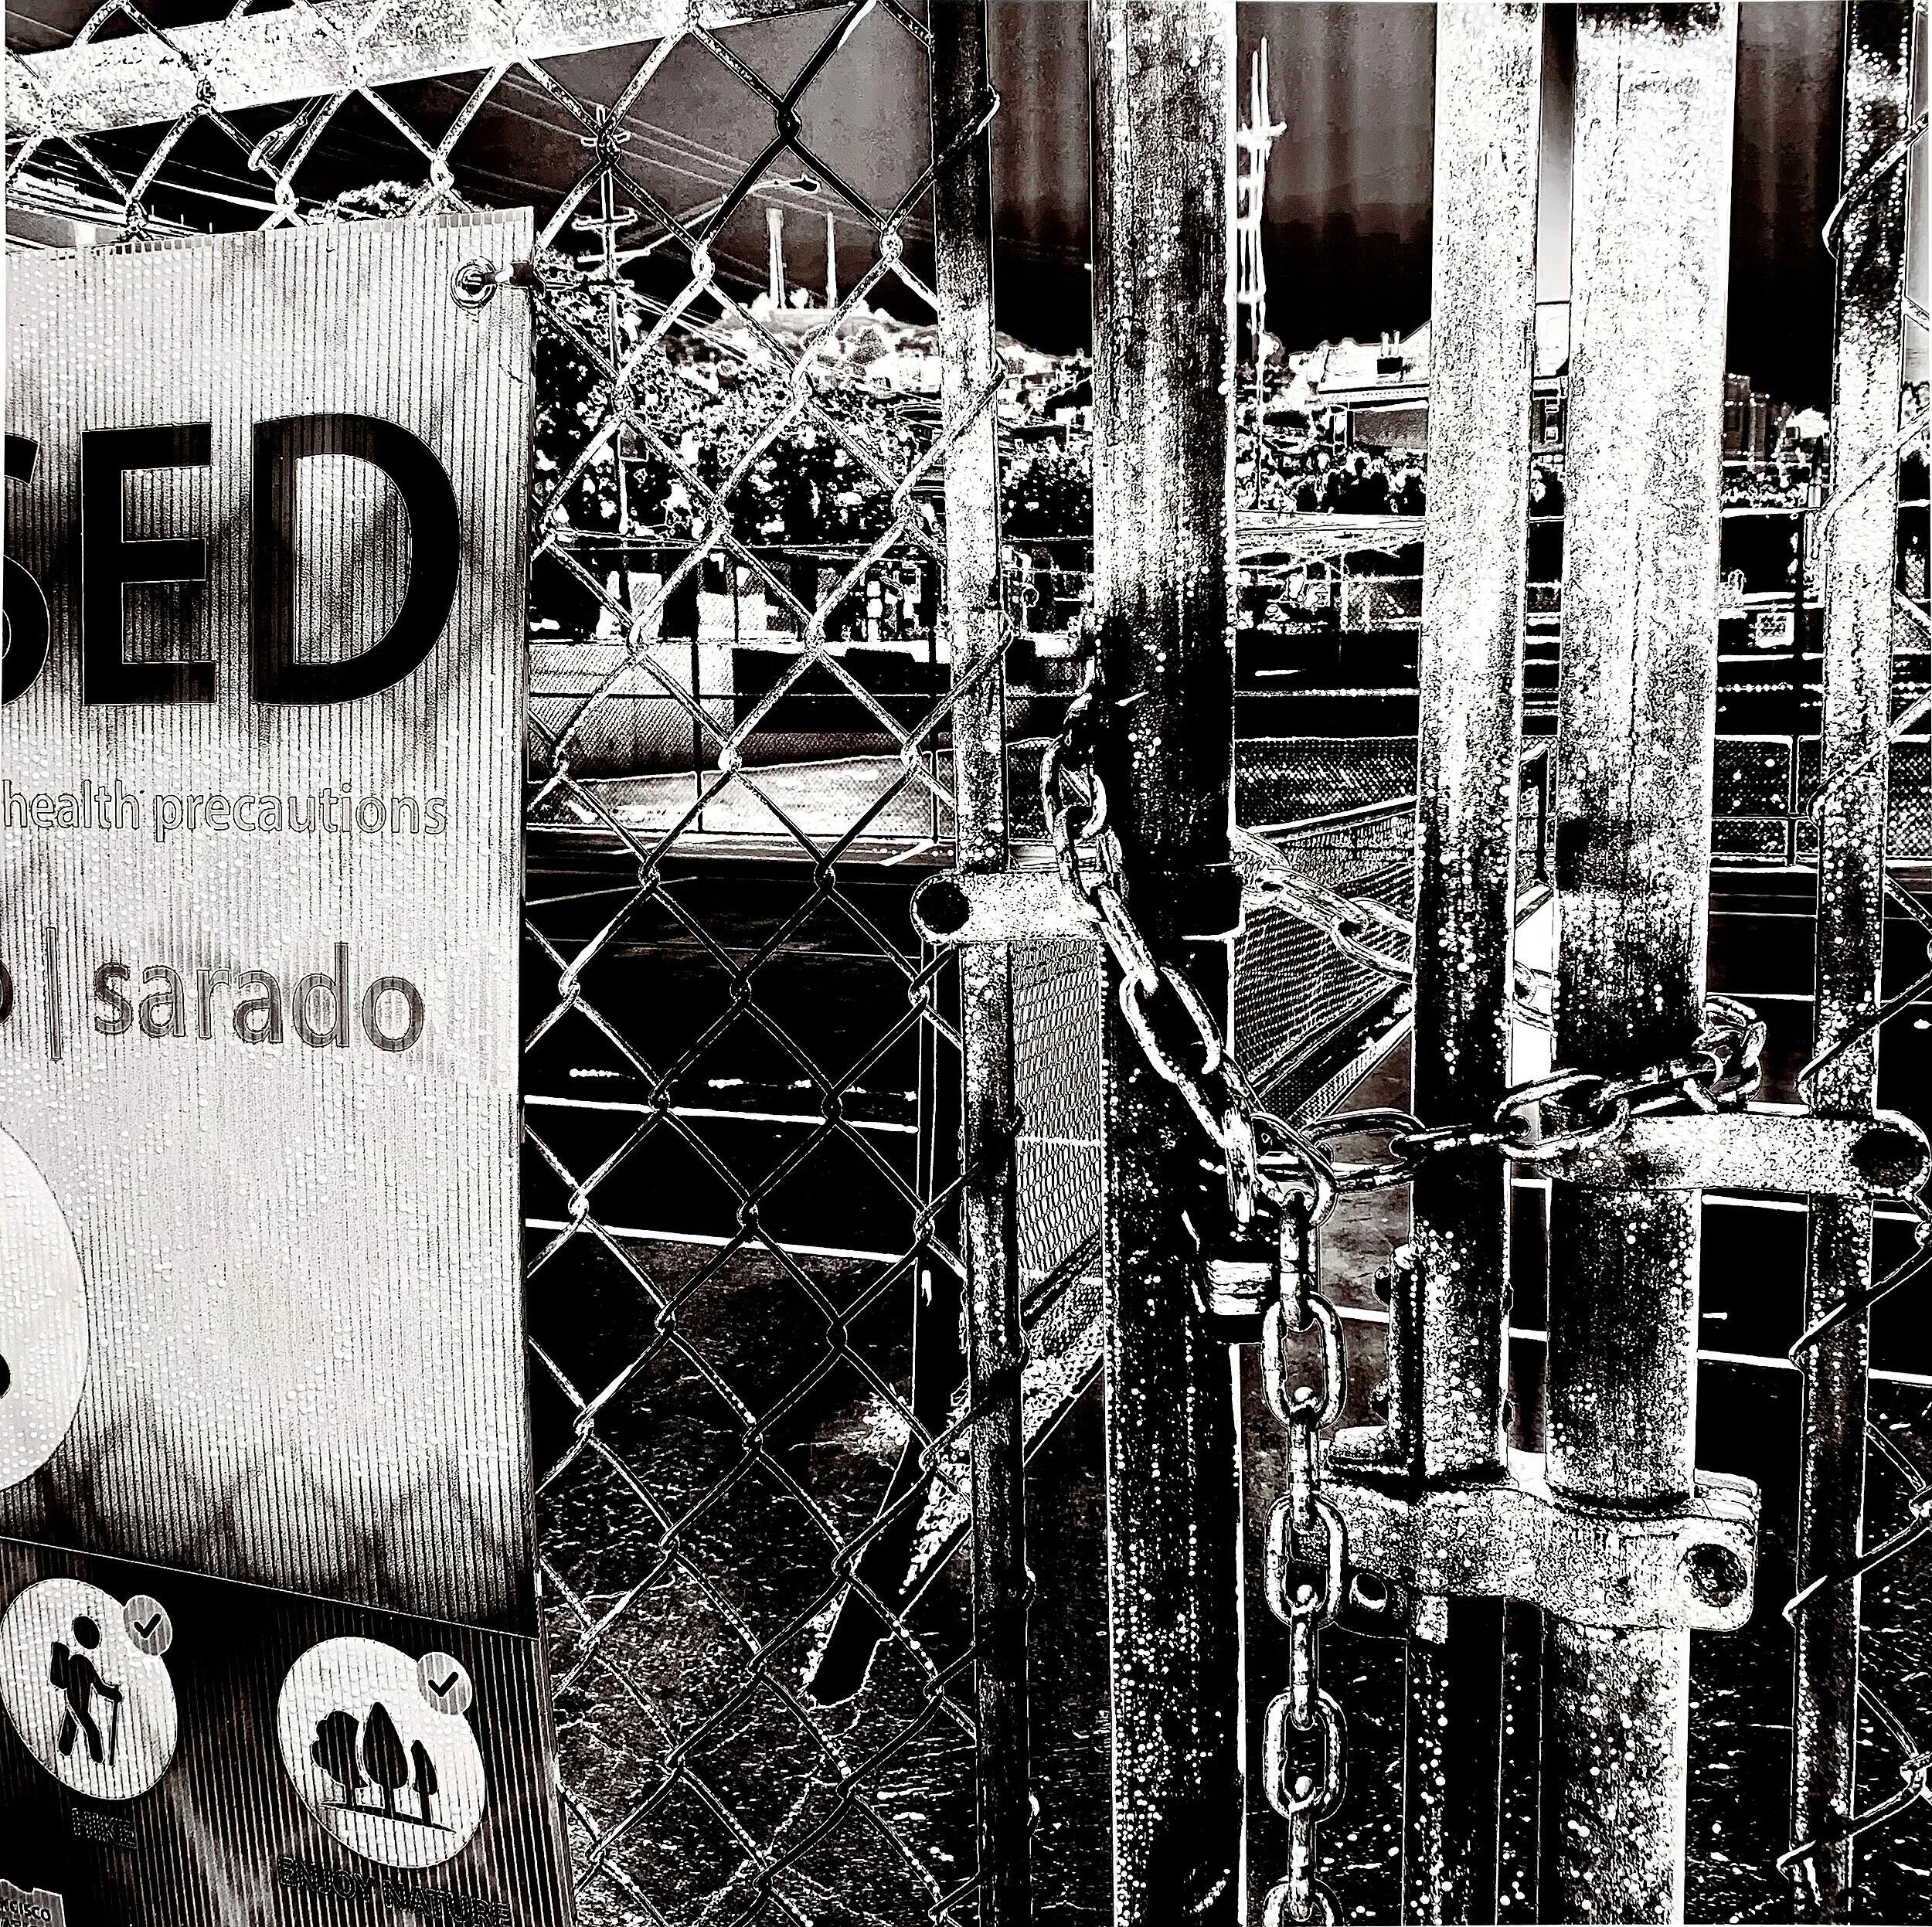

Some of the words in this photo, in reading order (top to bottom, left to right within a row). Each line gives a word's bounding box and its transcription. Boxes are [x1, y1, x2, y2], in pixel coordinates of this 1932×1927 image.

[3, 779, 140, 830] health
[155, 782, 447, 843] precautions
[94, 942, 424, 1052] sarado
[71, 1807, 137, 1849] HIKE
[277, 1855, 375, 1903] ENJOY
[383, 1879, 512, 1927] NATURE
